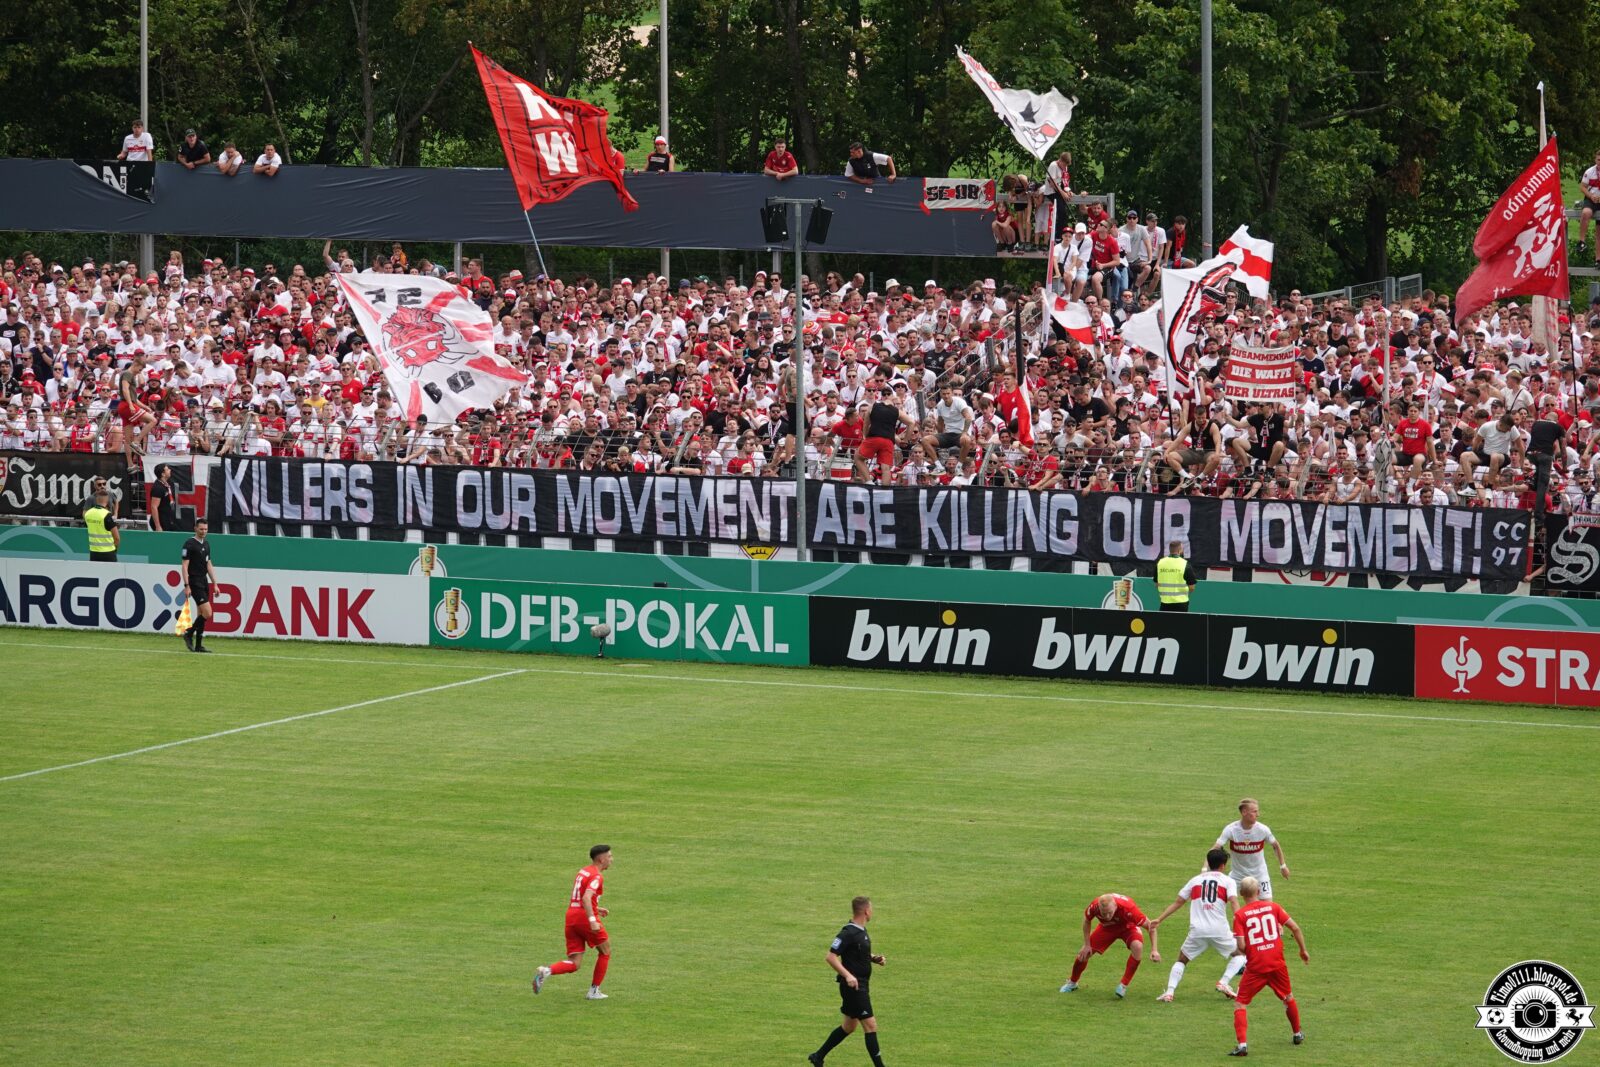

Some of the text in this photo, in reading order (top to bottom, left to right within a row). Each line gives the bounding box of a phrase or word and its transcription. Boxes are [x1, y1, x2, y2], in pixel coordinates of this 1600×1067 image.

[1225, 385, 1295, 399] DER ULTRAS
[1231, 365, 1292, 380] DIE WAFFE
[224, 456, 1483, 575] KILLERS IN OUR MOVEMENT ARE KILLING OUR MOVEMENT!
[1492, 521, 1527, 541] CC
[1491, 546, 1524, 567] 97
[203, 582, 376, 639] BANK
[480, 591, 790, 654] DFB-POKAL
[846, 608, 991, 666] bwin
[1032, 616, 1180, 676] bwin
[1222, 626, 1375, 686] bwin
[1495, 645, 1600, 693] STR
[1201, 879, 1218, 904] 10
[1245, 913, 1279, 946] 20
